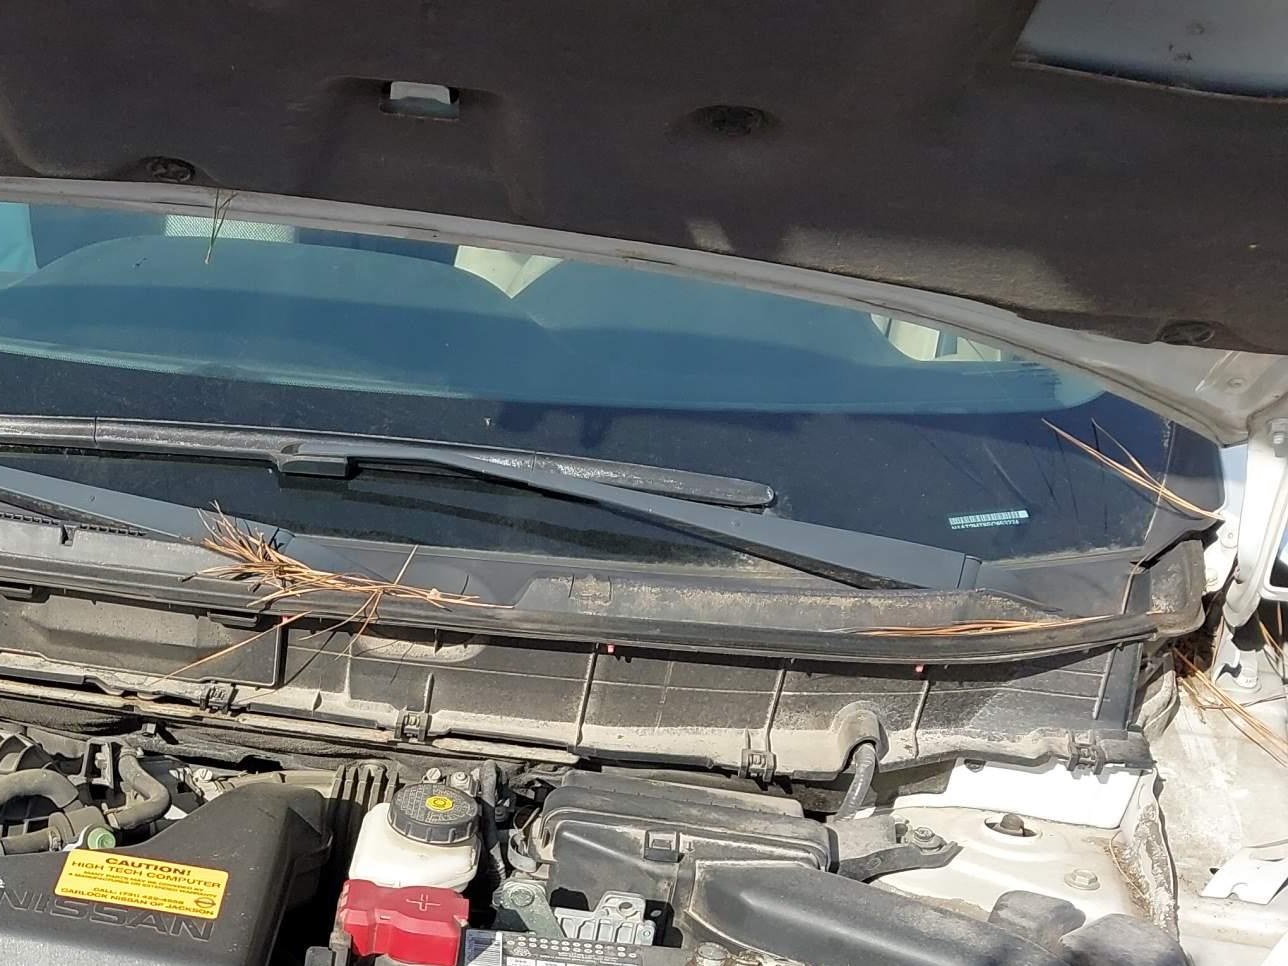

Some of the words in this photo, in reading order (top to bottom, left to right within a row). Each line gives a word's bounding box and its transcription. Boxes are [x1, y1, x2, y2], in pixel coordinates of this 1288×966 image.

[71, 860, 105, 871] HIGH
[107, 865, 143, 877] TECH
[146, 872, 222, 889] COMPUTER
[105, 857, 192, 877] CAUTION!
[110, 895, 148, 905] NISSAN
[165, 903, 215, 916] JACKSON
